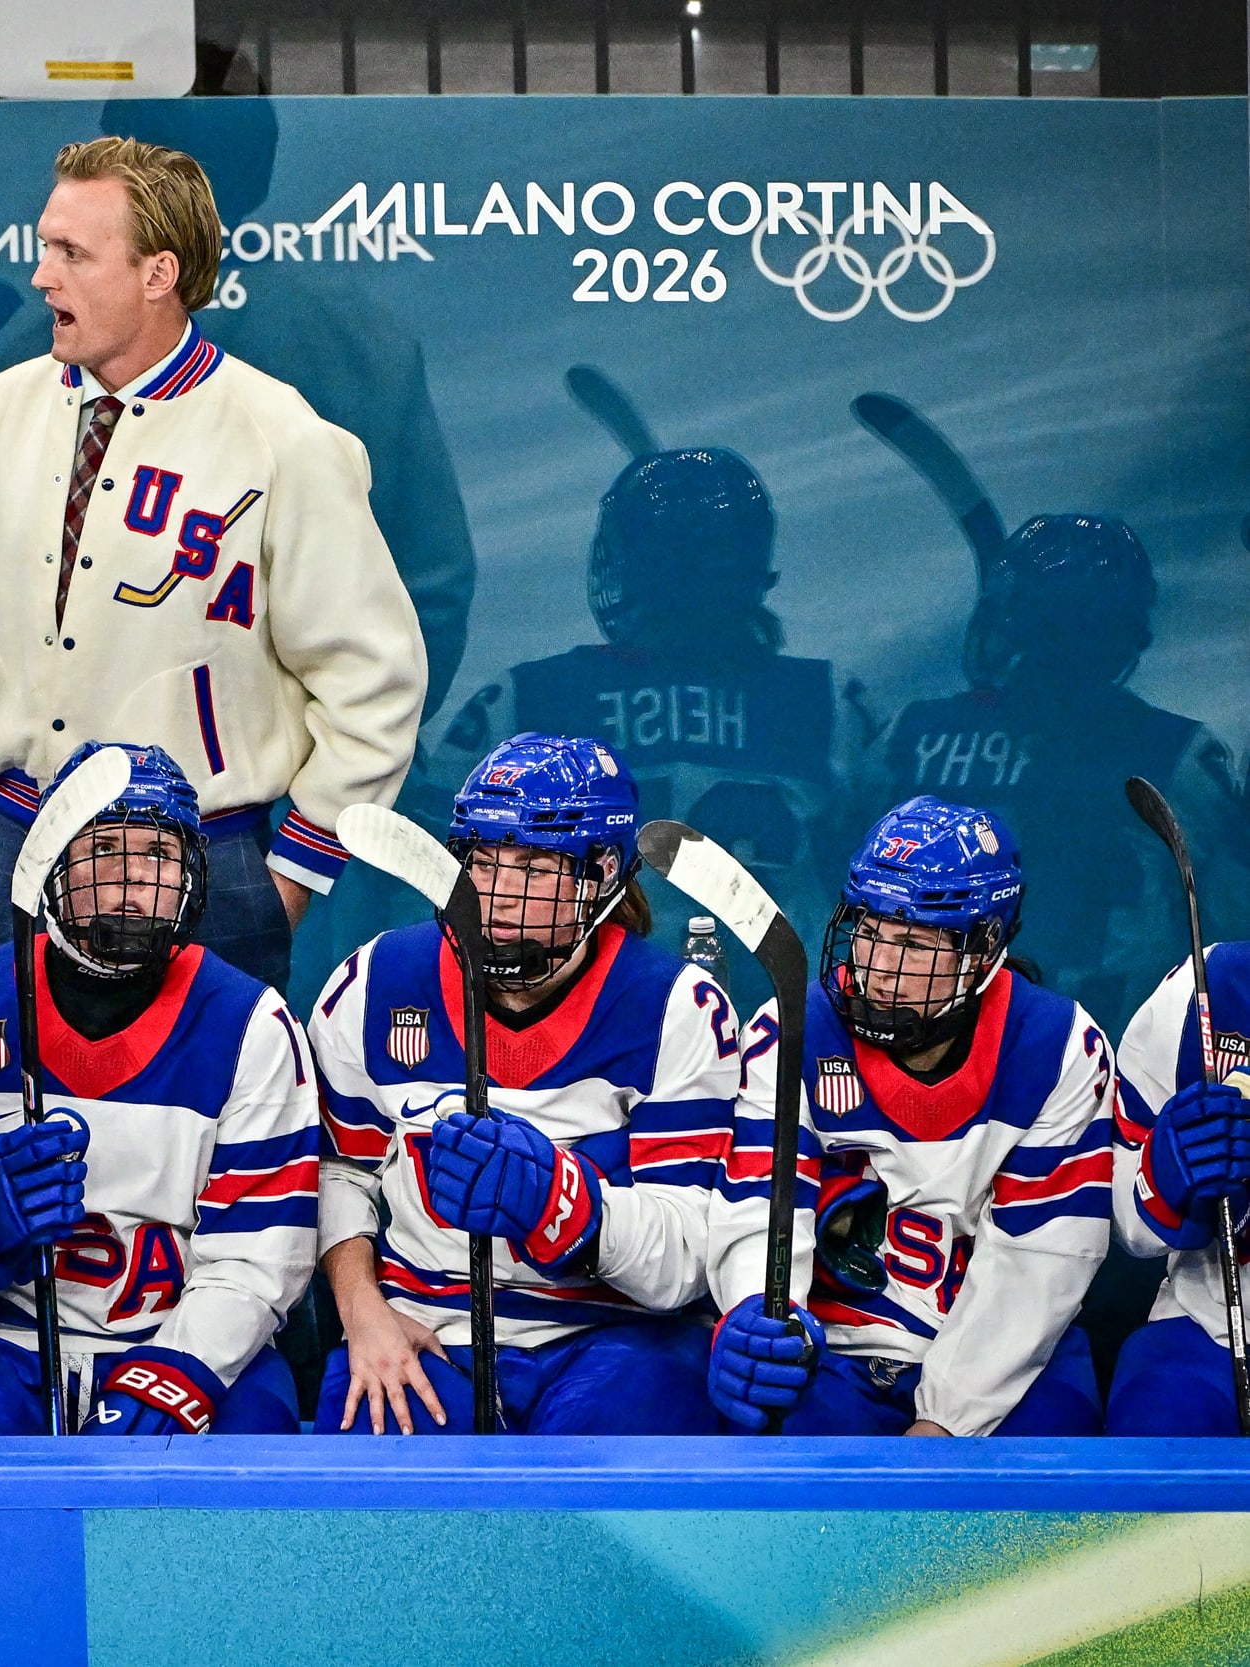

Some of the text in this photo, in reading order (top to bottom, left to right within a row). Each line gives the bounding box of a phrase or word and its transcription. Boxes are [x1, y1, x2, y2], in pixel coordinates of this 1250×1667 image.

[304, 181, 993, 235] MILANO CORTINA
[221, 222, 434, 262] ORTINA
[572, 248, 727, 303] 2026
[124, 464, 255, 631] USA
[486, 766, 527, 786] 27
[606, 814, 634, 825] CCM
[882, 837, 922, 863] 37
[991, 884, 1021, 902] CCM
[397, 1013, 421, 1026] USA
[1199, 1015, 1214, 1068] CCM
[1219, 1036, 1246, 1053] USA
[824, 1061, 851, 1075] USA
